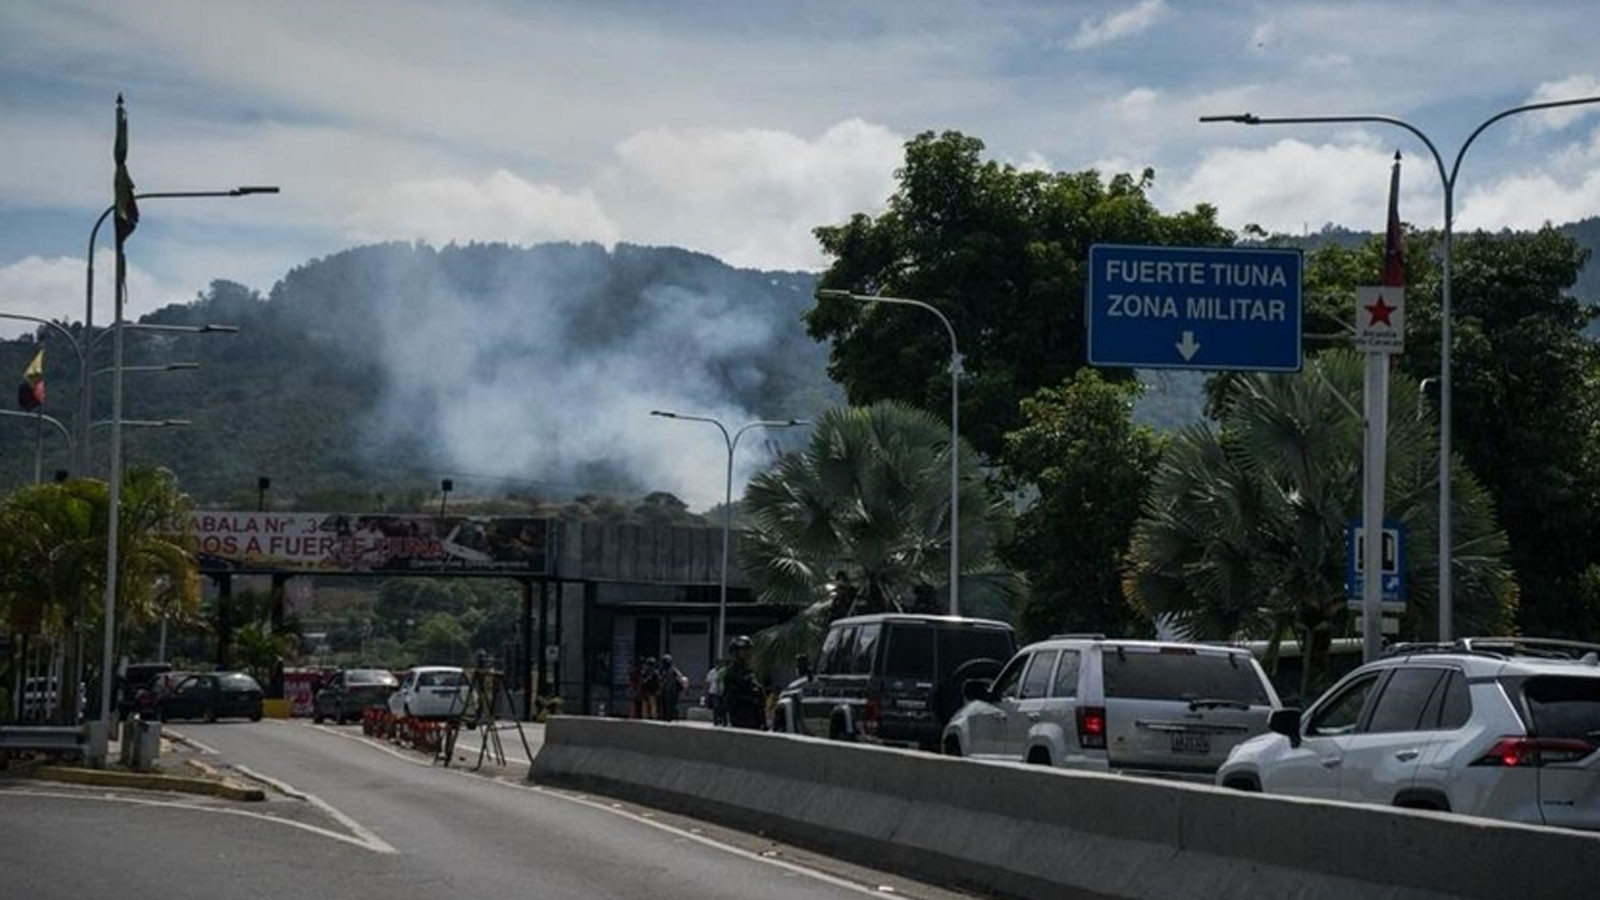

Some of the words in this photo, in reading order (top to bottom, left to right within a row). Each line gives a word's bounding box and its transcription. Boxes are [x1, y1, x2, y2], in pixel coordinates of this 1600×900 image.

[1106, 260, 1205, 284] FUERTE
[1211, 264, 1287, 287] TIUNA
[1107, 294, 1178, 318] ZONA
[1186, 297, 1286, 322] MILITAR
[245, 536, 262, 555] A
[270, 537, 366, 557] FUERTE
